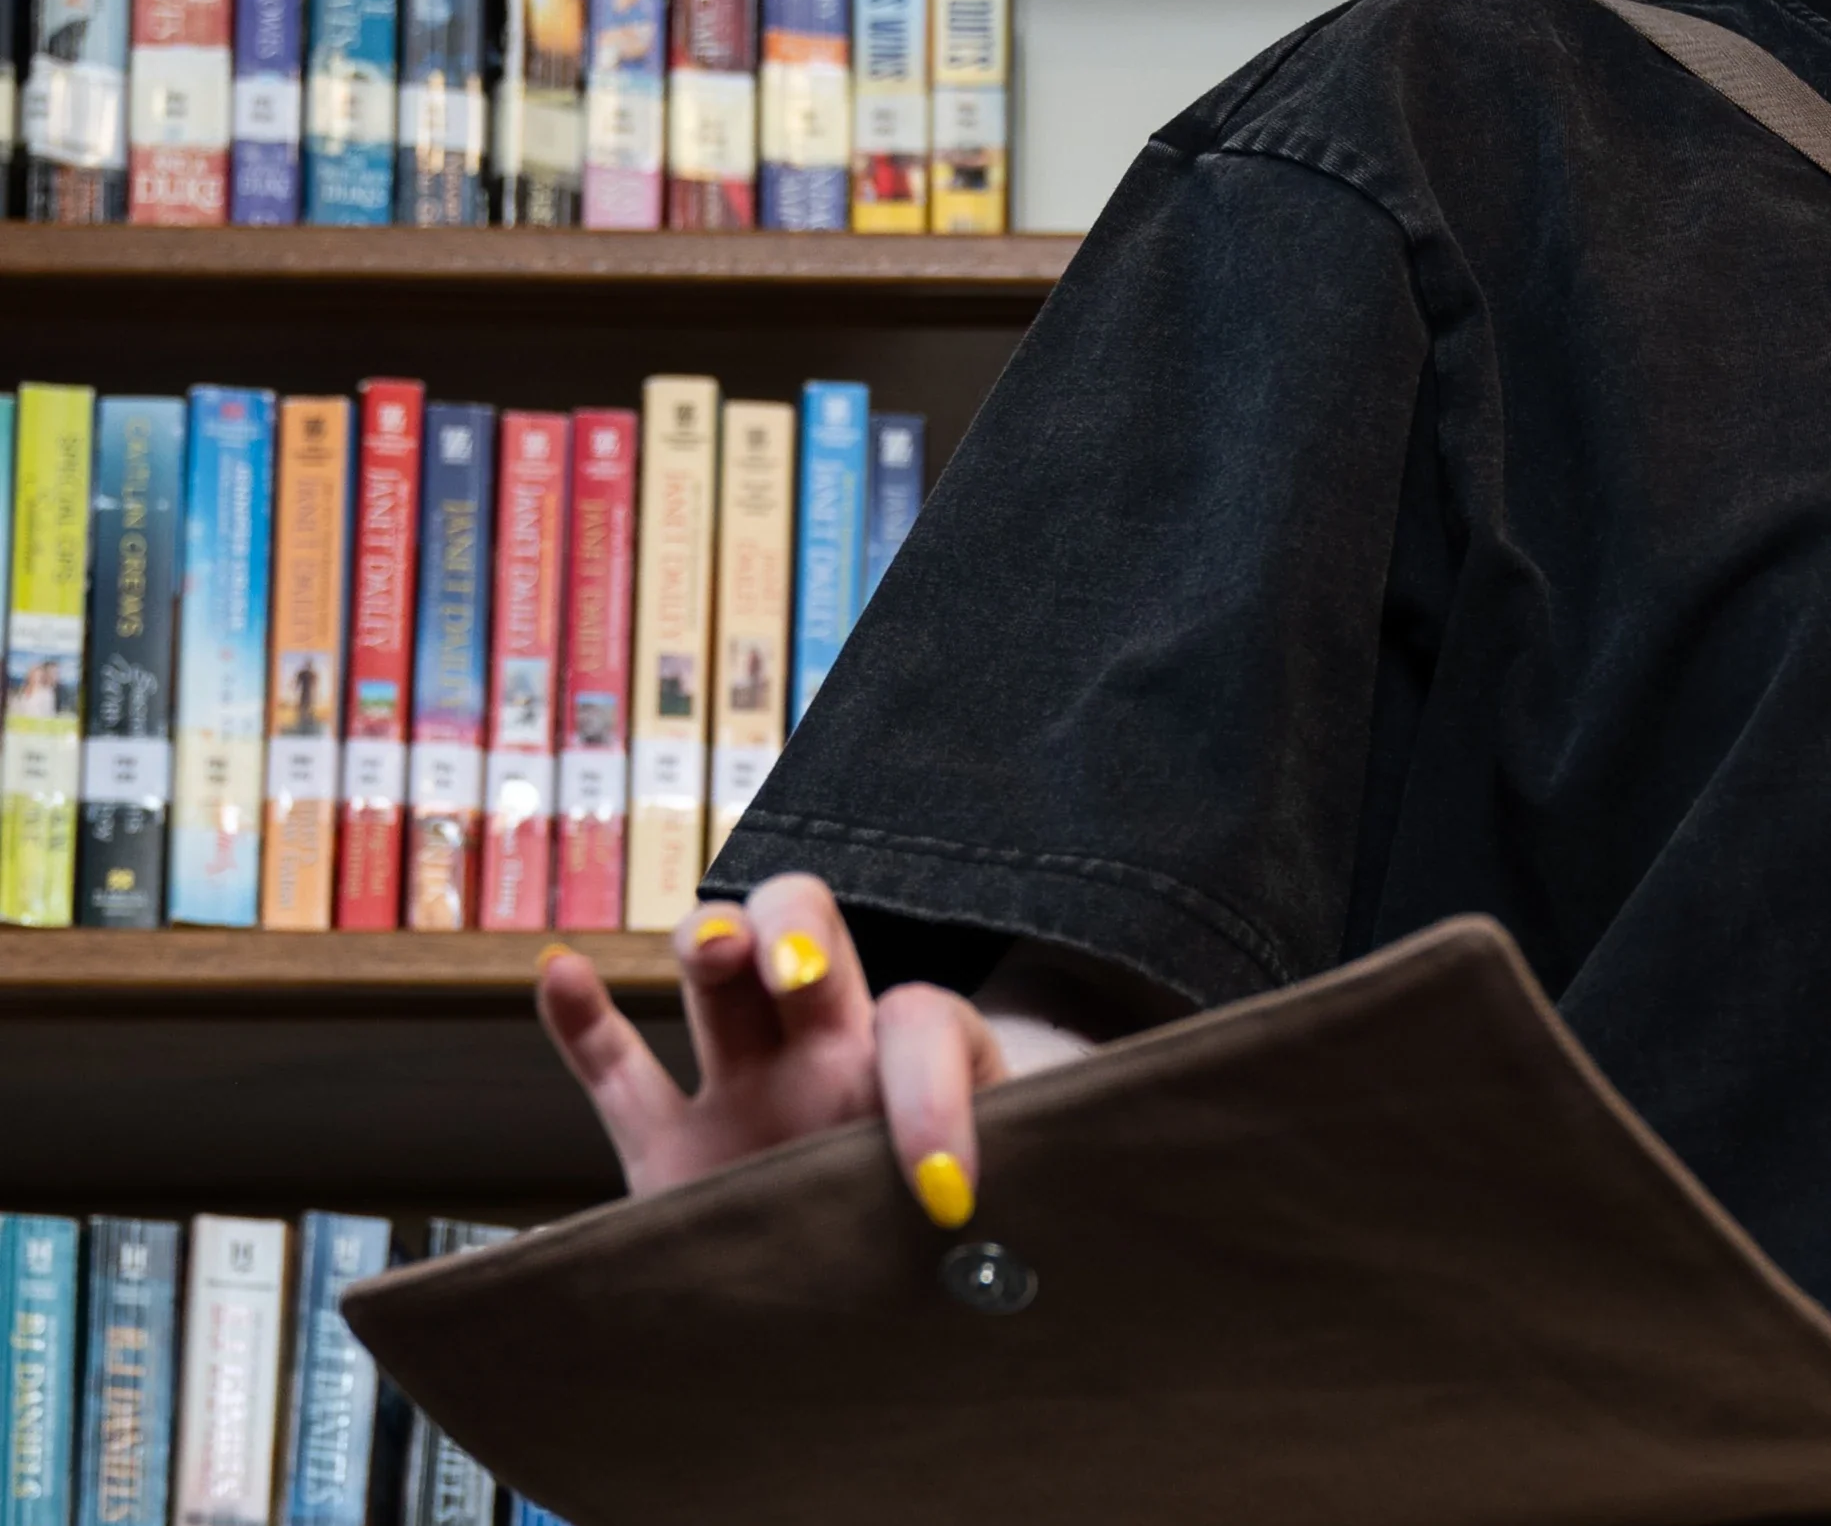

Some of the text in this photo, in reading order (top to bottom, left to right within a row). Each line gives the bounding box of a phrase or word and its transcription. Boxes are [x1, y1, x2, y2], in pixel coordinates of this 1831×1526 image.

[868, 20, 909, 81] WINS
[116, 533, 147, 637] CREWS
[360, 470, 401, 651] JANET DAILEY
[441, 499, 479, 591] JANET
[508, 485, 546, 651] JANET DAILEY
[303, 1372, 356, 1505] DANIELS
